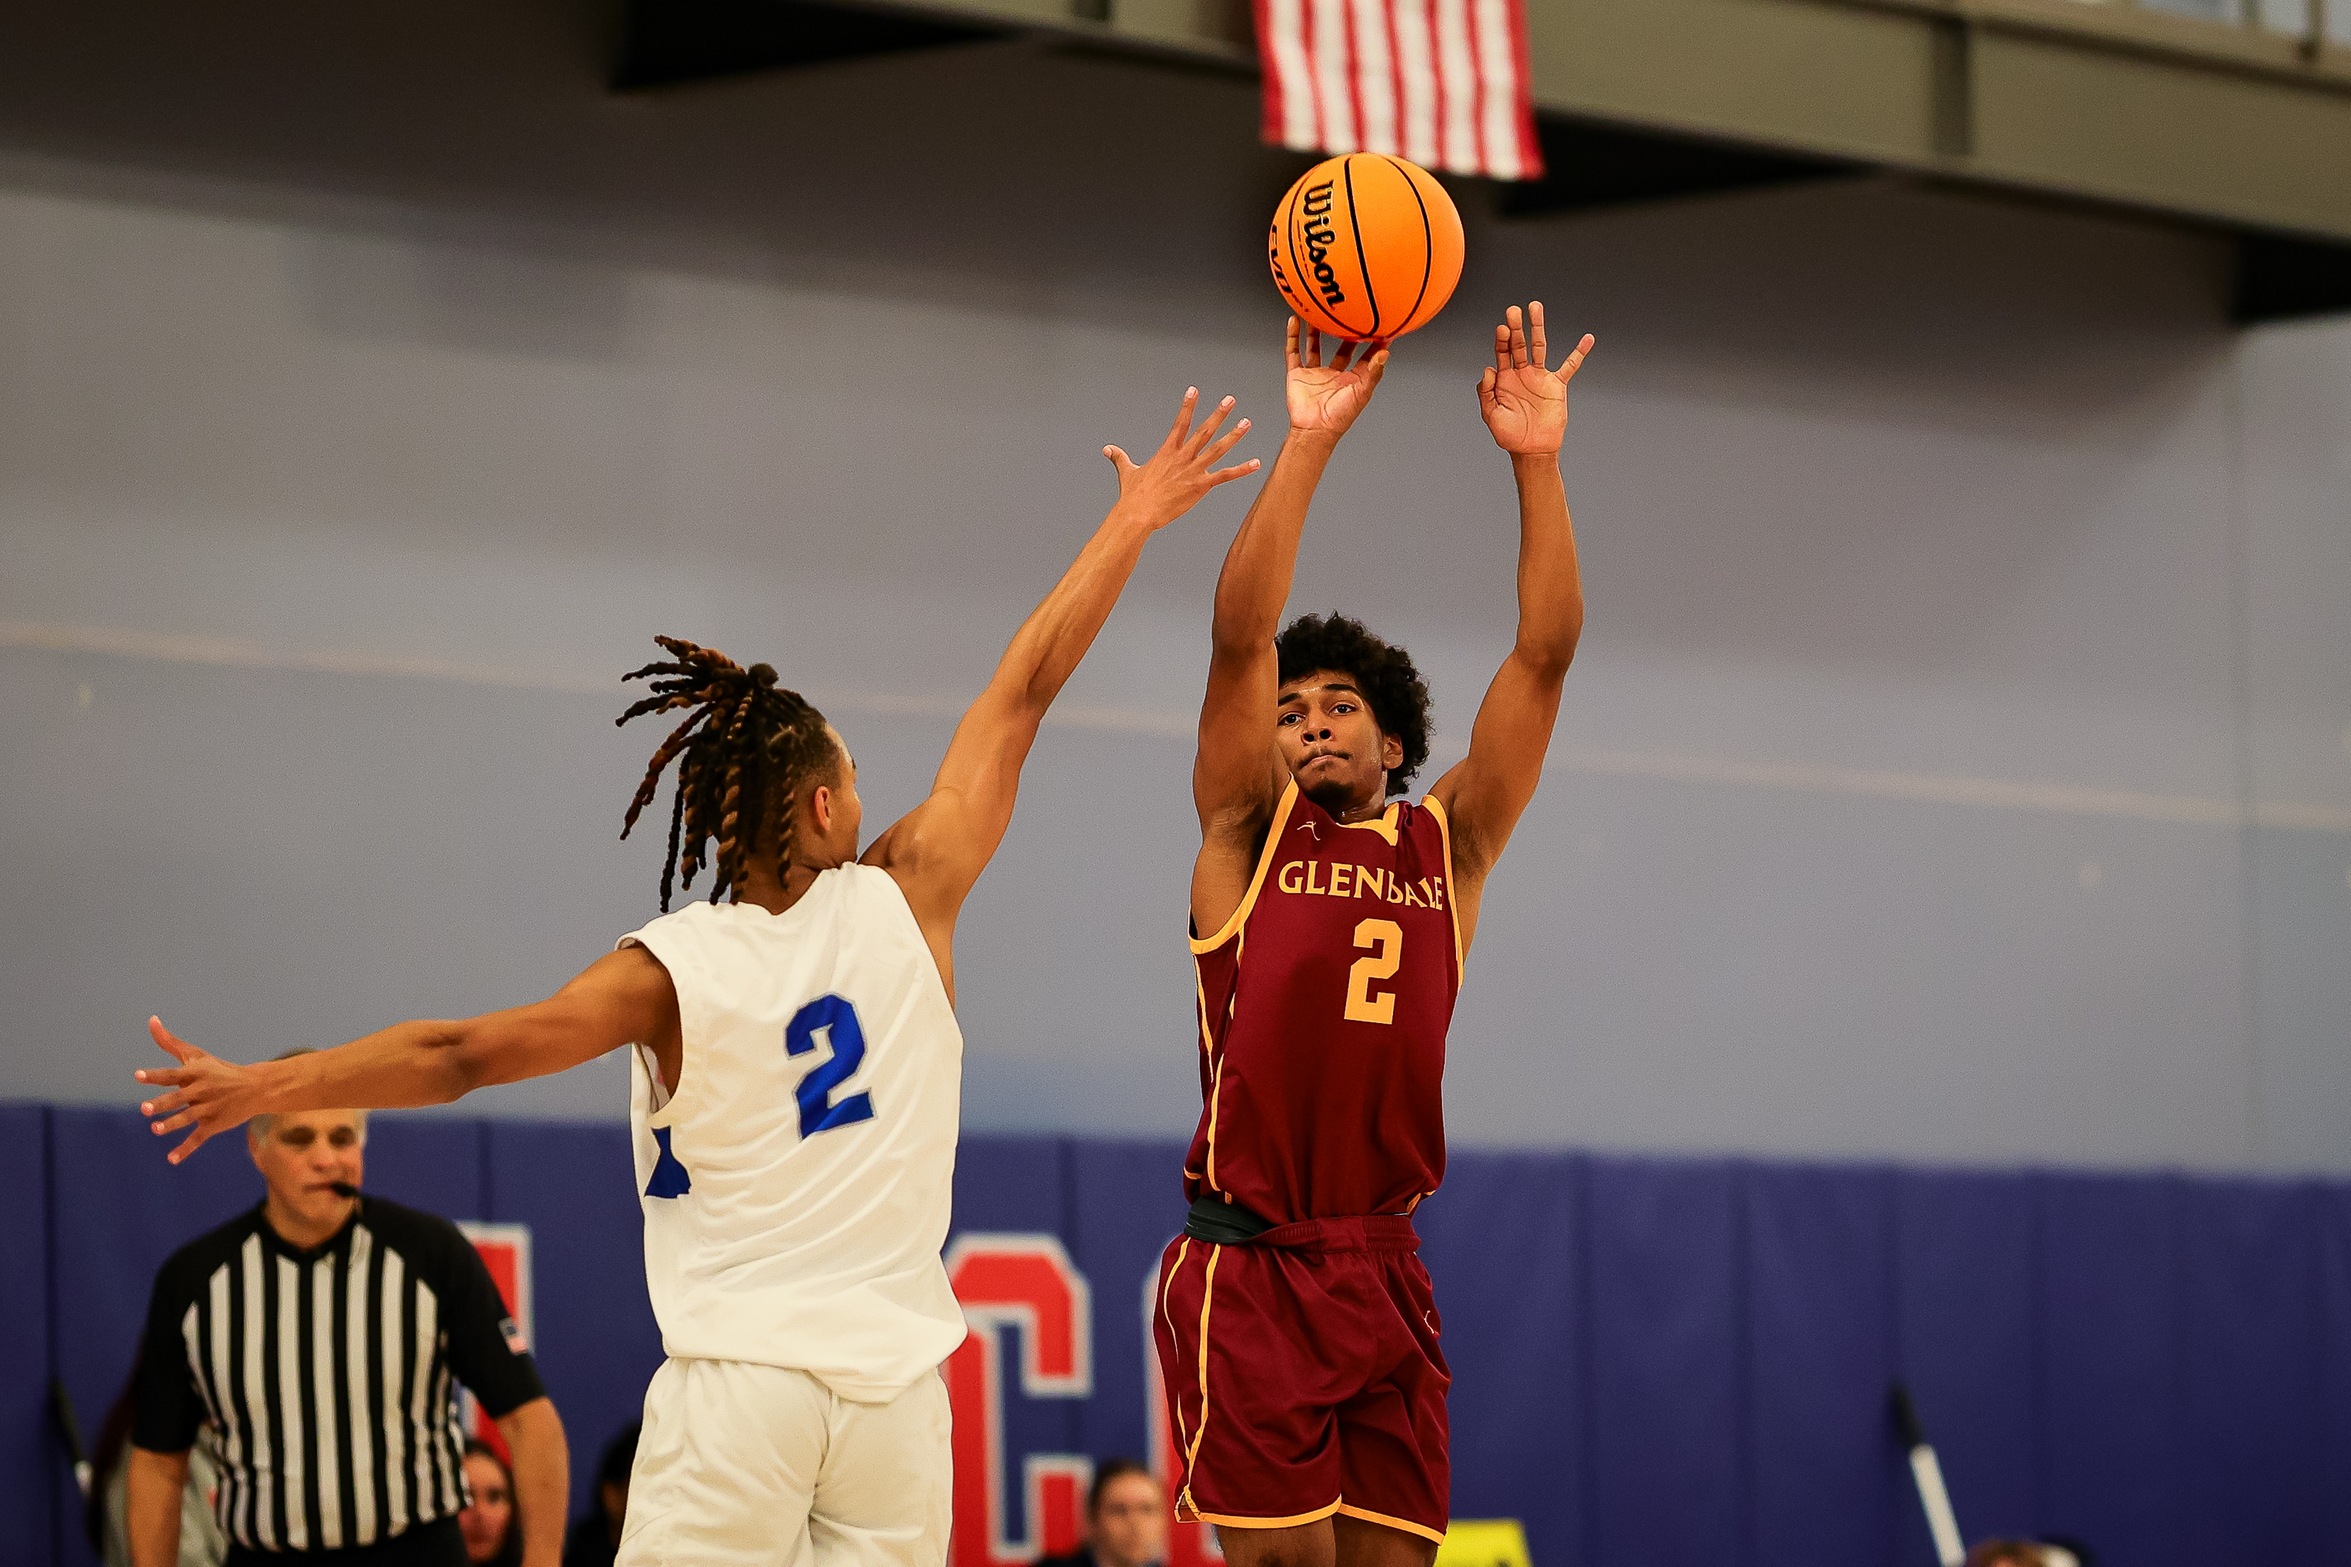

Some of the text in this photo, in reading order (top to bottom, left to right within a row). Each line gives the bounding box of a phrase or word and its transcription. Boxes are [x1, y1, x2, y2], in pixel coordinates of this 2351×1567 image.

[1303, 179, 1346, 311] Wilson
[1278, 860, 1444, 912] GLENDALE
[1343, 917, 1404, 1026] 2
[784, 991, 877, 1142] 2
